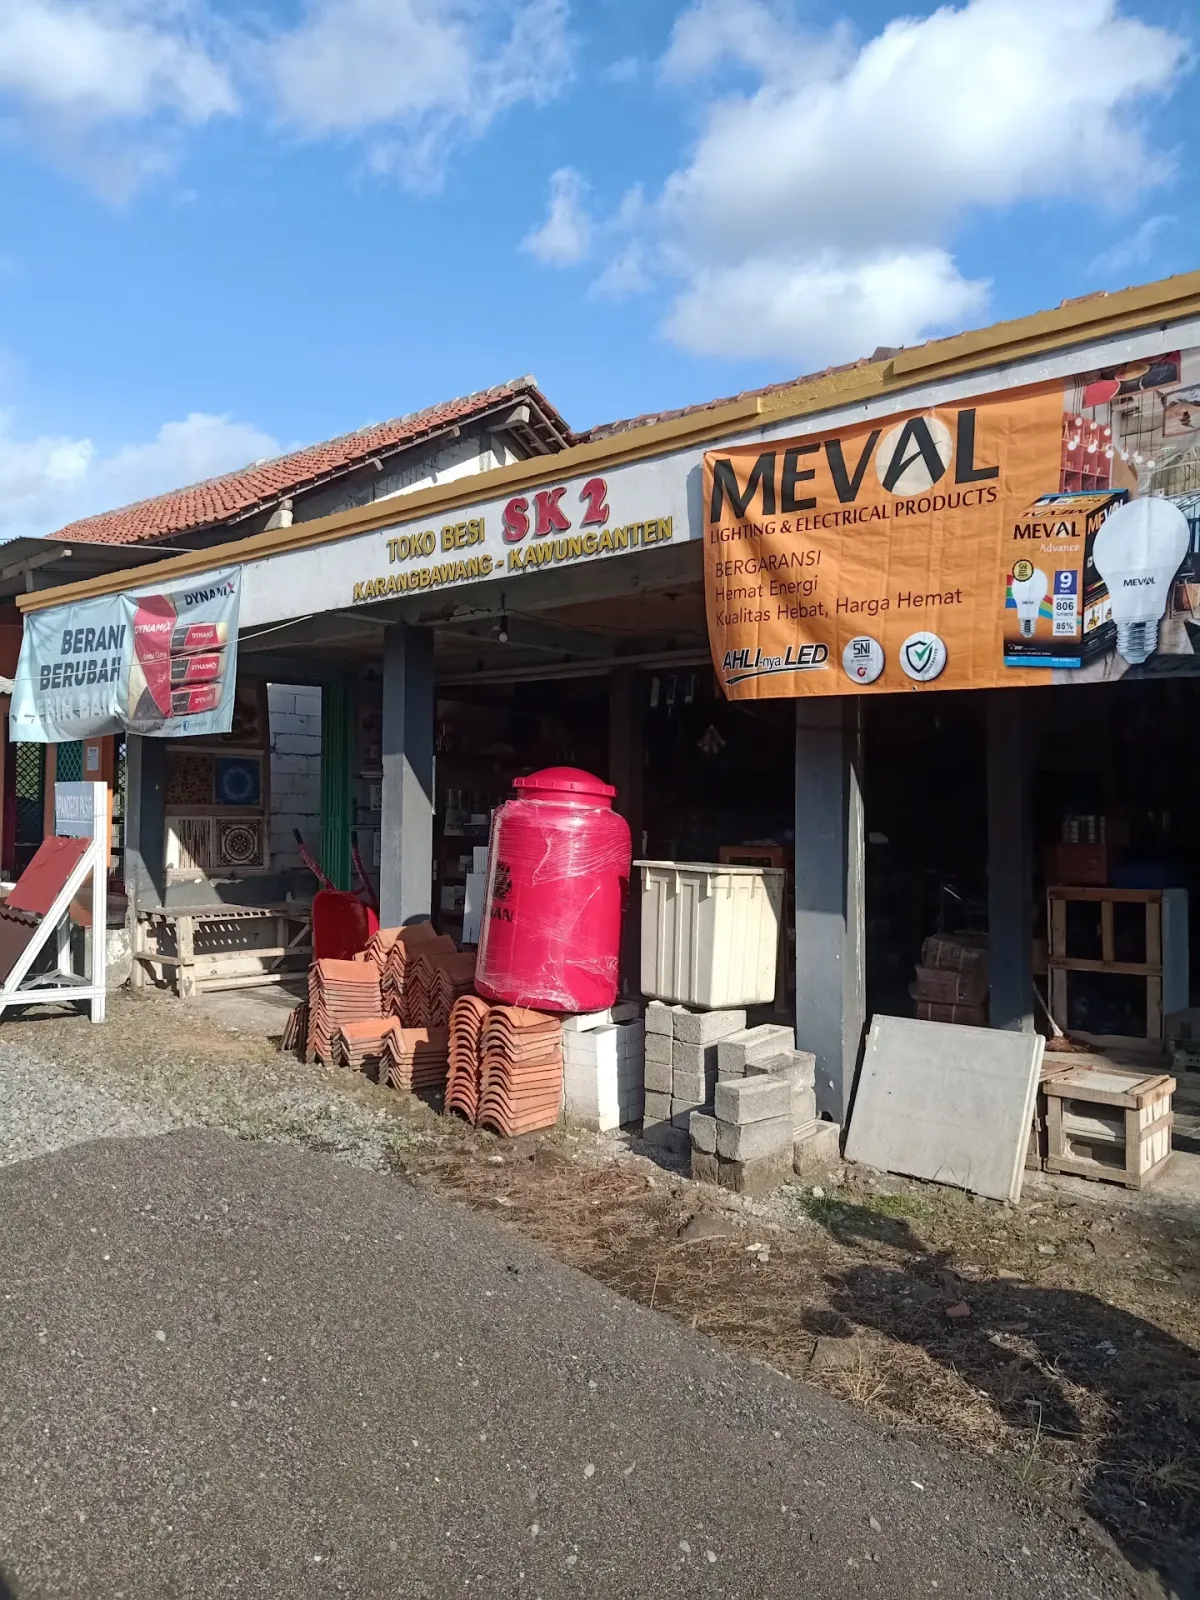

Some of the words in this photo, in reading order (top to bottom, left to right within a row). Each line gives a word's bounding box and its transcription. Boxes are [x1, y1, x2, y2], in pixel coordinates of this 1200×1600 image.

[711, 408, 999, 523] MEVAL
[387, 530, 435, 562] TOKO
[441, 517, 485, 550] BESI
[502, 487, 572, 541] SK
[580, 477, 611, 527] 2
[711, 522, 776, 544] LIGHTING
[780, 521, 793, 534] &
[796, 505, 890, 532] ELECTRICAL
[895, 487, 998, 517] PRODUCTS
[1013, 521, 1081, 540] MEVAL
[353, 555, 492, 601] KARANGBAWANG
[508, 516, 674, 569] KAWUNGANTEN
[1039, 543, 1080, 553] Advance
[715, 550, 821, 578] BERGARANSI
[716, 584, 763, 602] Hemat
[770, 575, 818, 597] Energi
[1059, 572, 1073, 588] 9
[1123, 577, 1156, 588] MEVAL
[185, 582, 236, 606] DYNAMIX
[716, 607, 771, 627] Kualitas
[777, 601, 829, 620] Hebat,
[836, 598, 890, 618] Harga
[897, 588, 963, 608] Hemat
[1056, 601, 1075, 611] 806
[135, 620, 173, 635] DYNAMIX
[1056, 622, 1074, 630] 85%
[60, 624, 127, 656] BERANI
[853, 641, 871, 656] SNI
[722, 648, 781, 670] AHLI-nya
[784, 643, 829, 666] LED
[39, 656, 122, 691] BERUBAH
